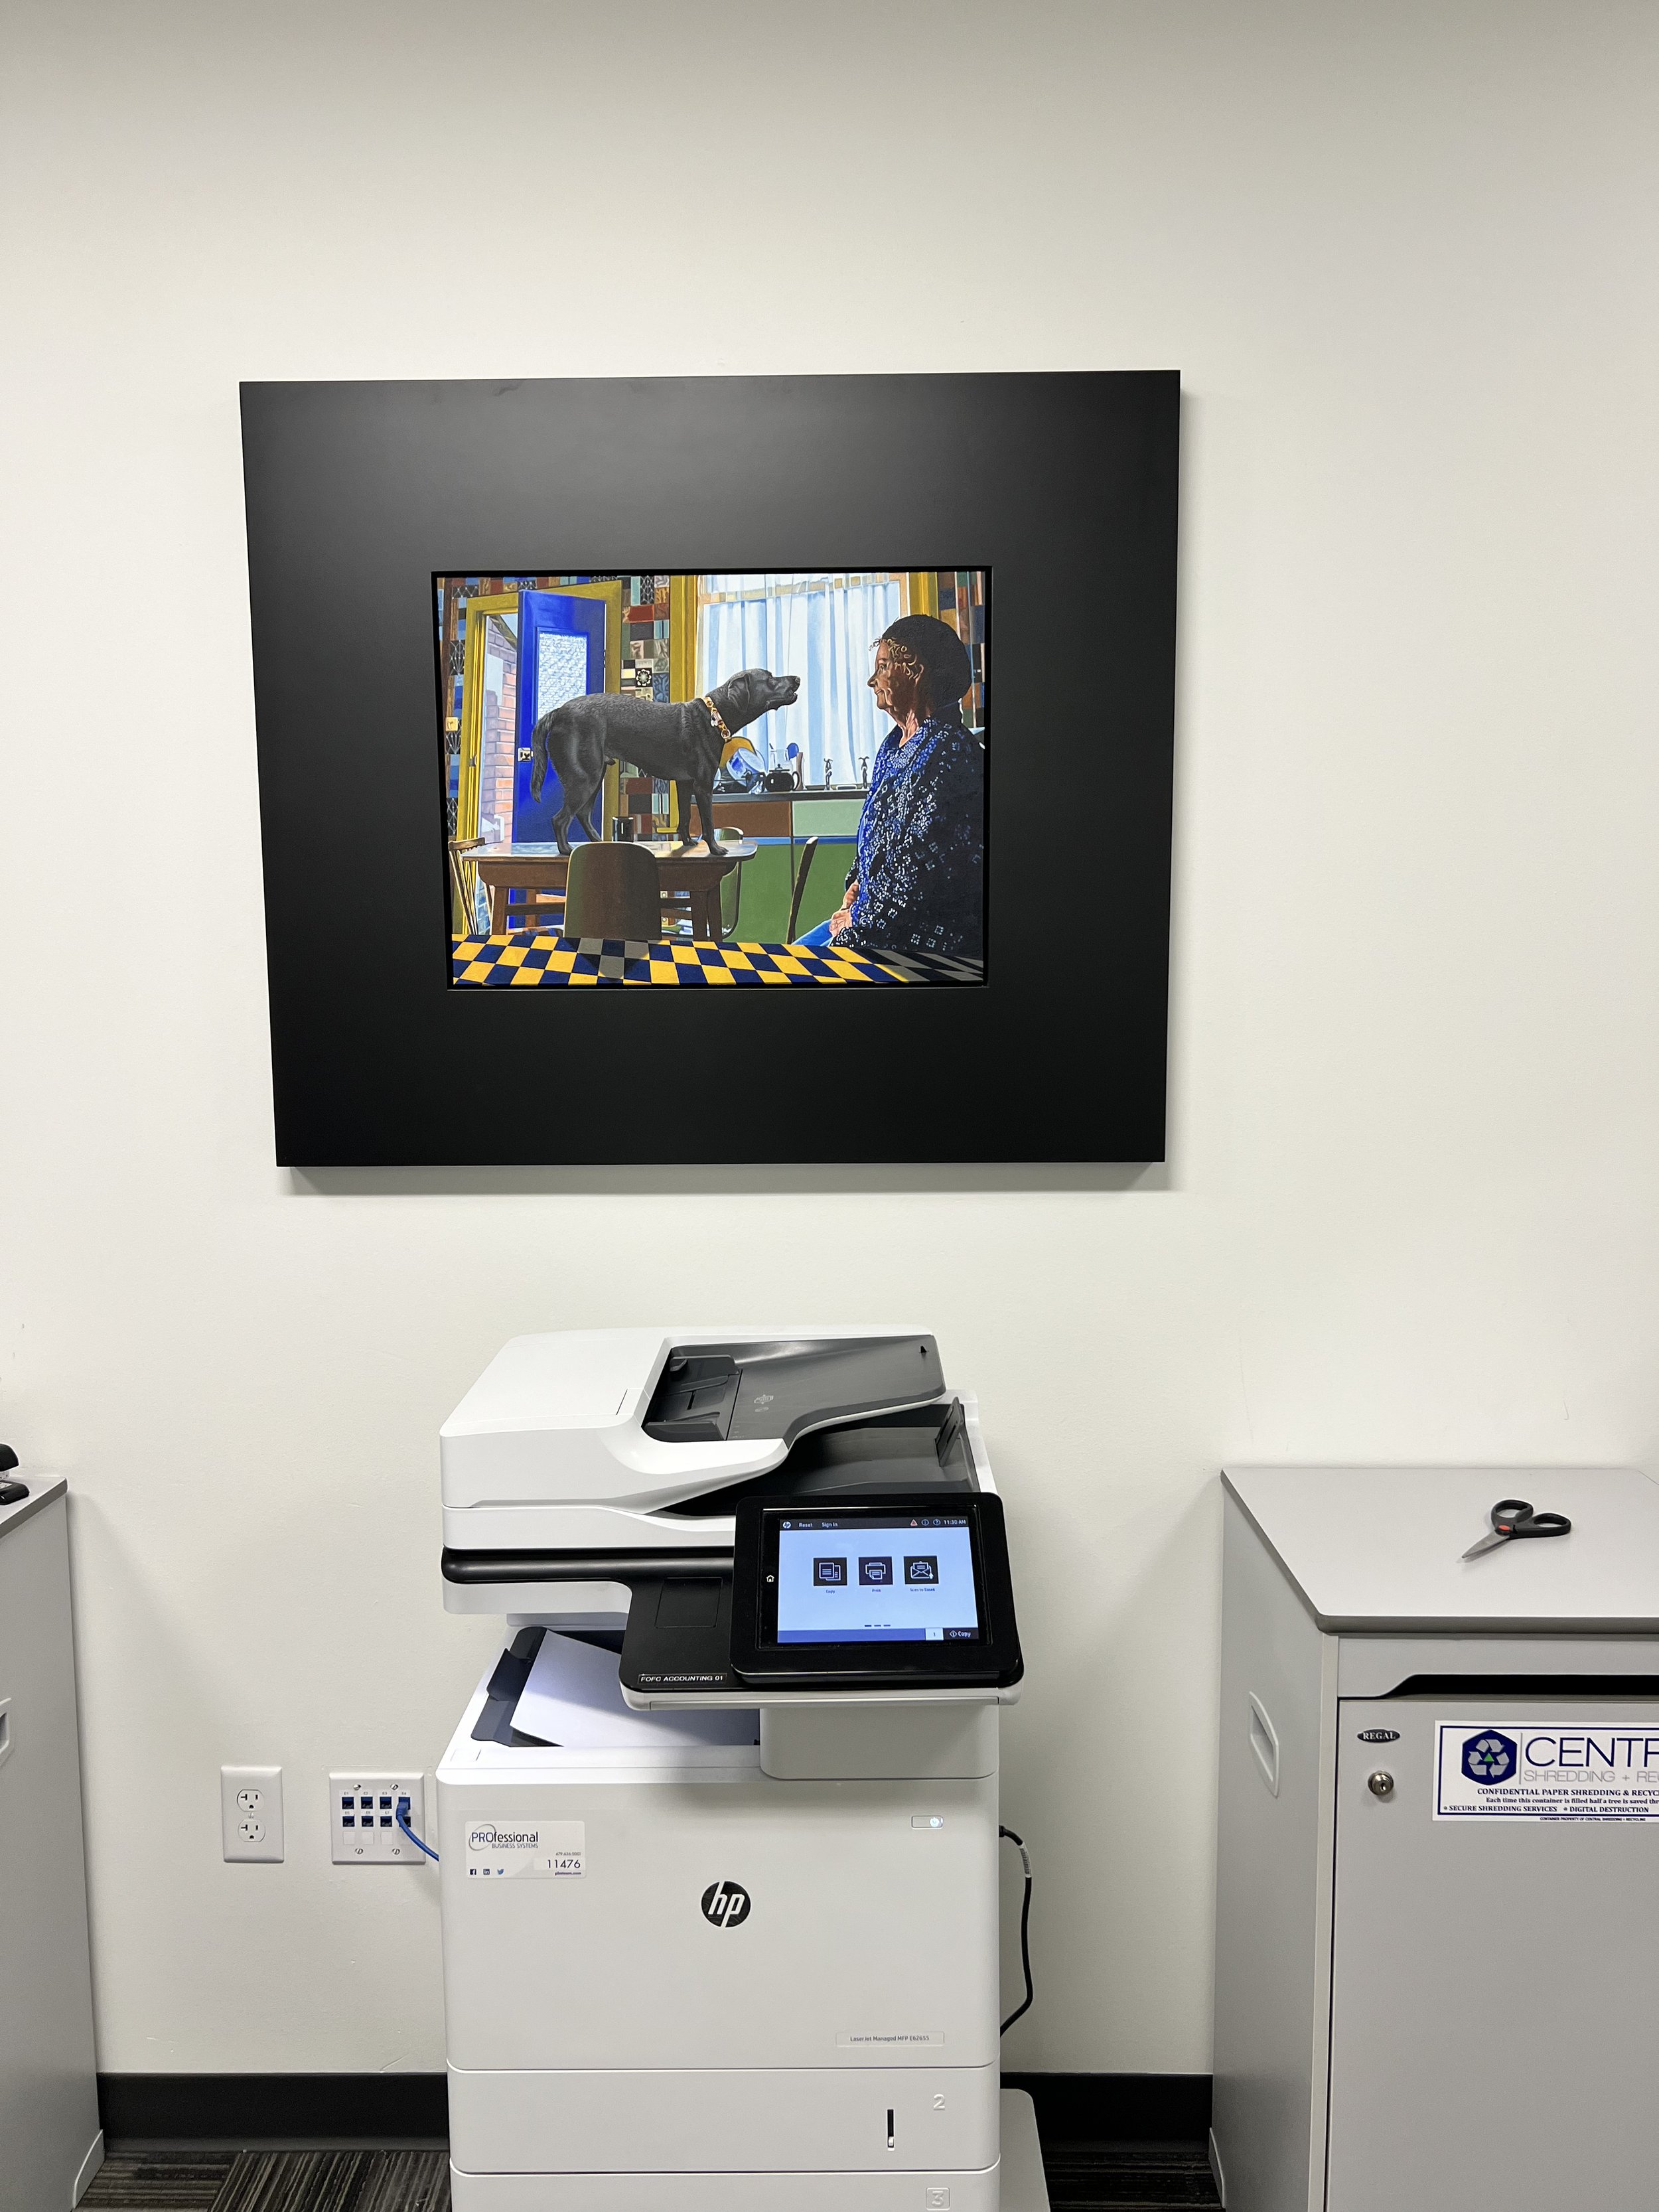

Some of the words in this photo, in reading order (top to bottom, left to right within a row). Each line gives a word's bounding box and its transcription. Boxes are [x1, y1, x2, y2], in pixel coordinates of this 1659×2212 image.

[1524, 1770, 1615, 1783] SHREDDING
[1636, 1771, 1659, 1783] RE
[471, 1832, 538, 1842] PROfessional
[547, 1860, 581, 1869] 11476
[707, 1881, 745, 1927] hp
[933, 2094, 946, 2110] 2
[932, 2191, 944, 2207] 3
